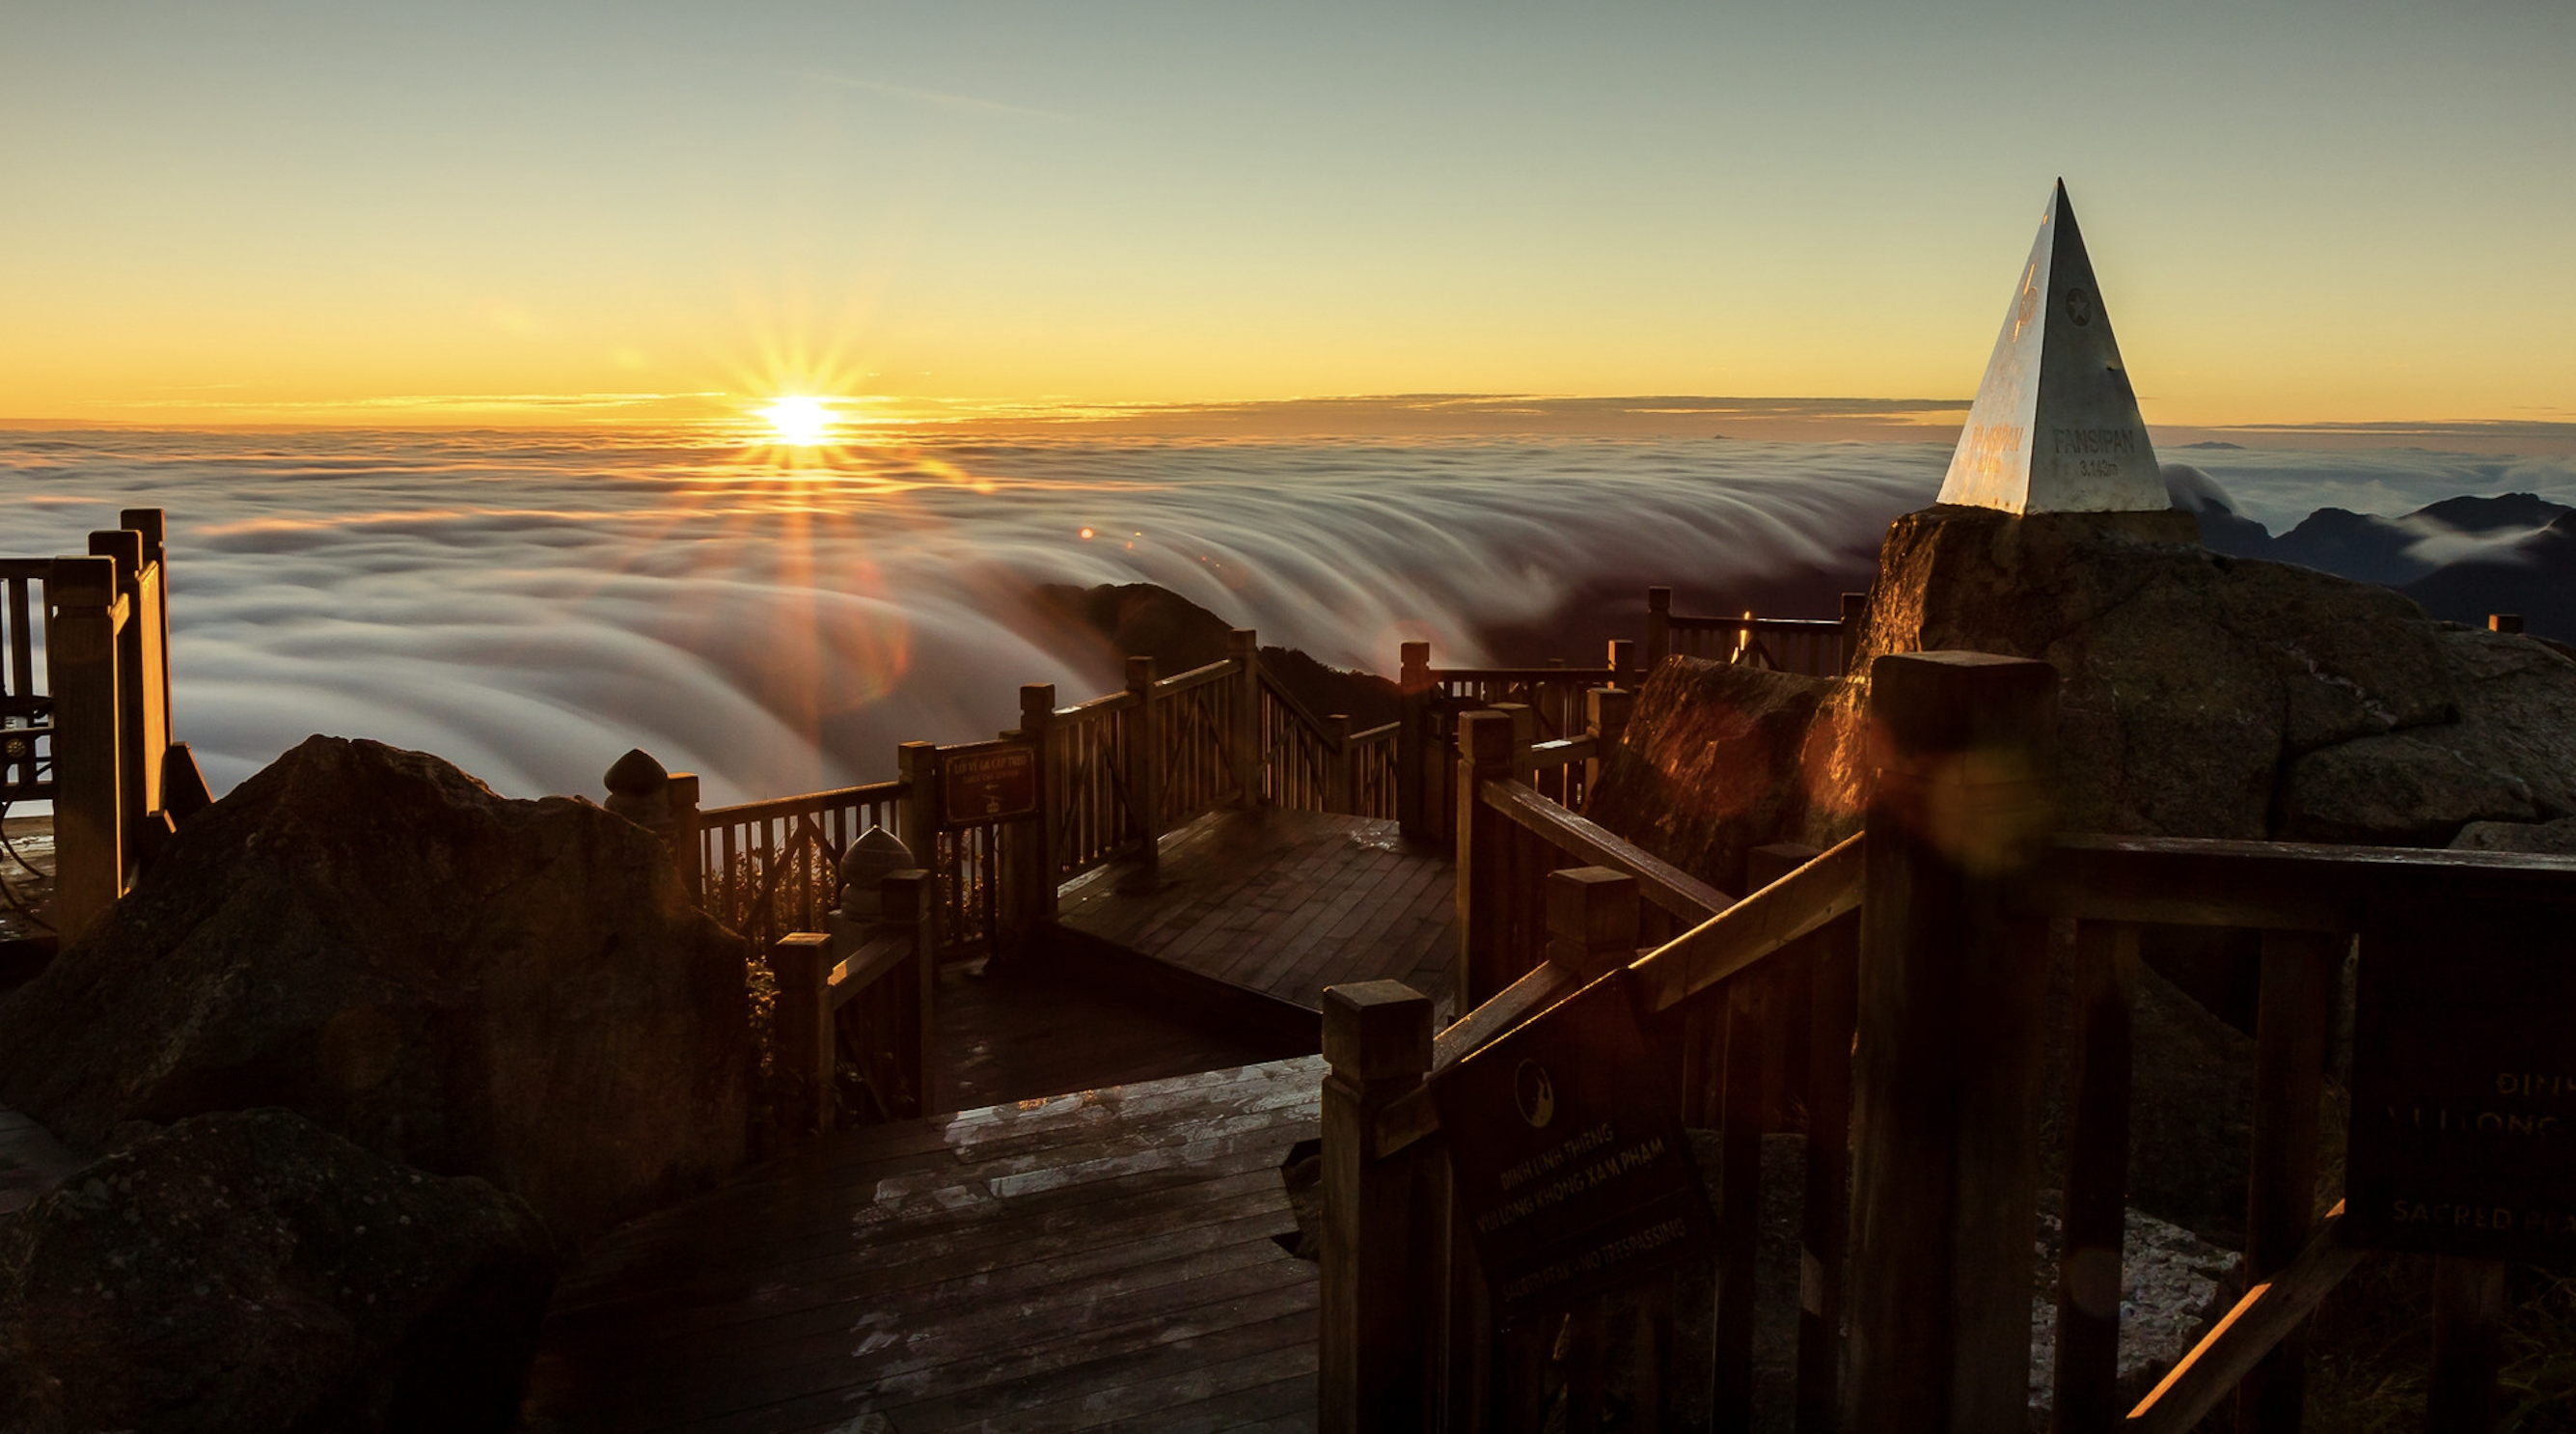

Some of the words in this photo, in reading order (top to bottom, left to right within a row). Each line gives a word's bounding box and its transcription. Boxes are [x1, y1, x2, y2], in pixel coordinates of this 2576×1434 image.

[2052, 427, 2134, 454] FANSIPAN
[2079, 460, 2119, 477] 3.143m
[1533, 1148, 1565, 1176] LINH
[1476, 1210, 1499, 1235] VUI
[1579, 1250, 1603, 1272] NO
[1601, 1217, 1687, 1264] TRESPASSING
